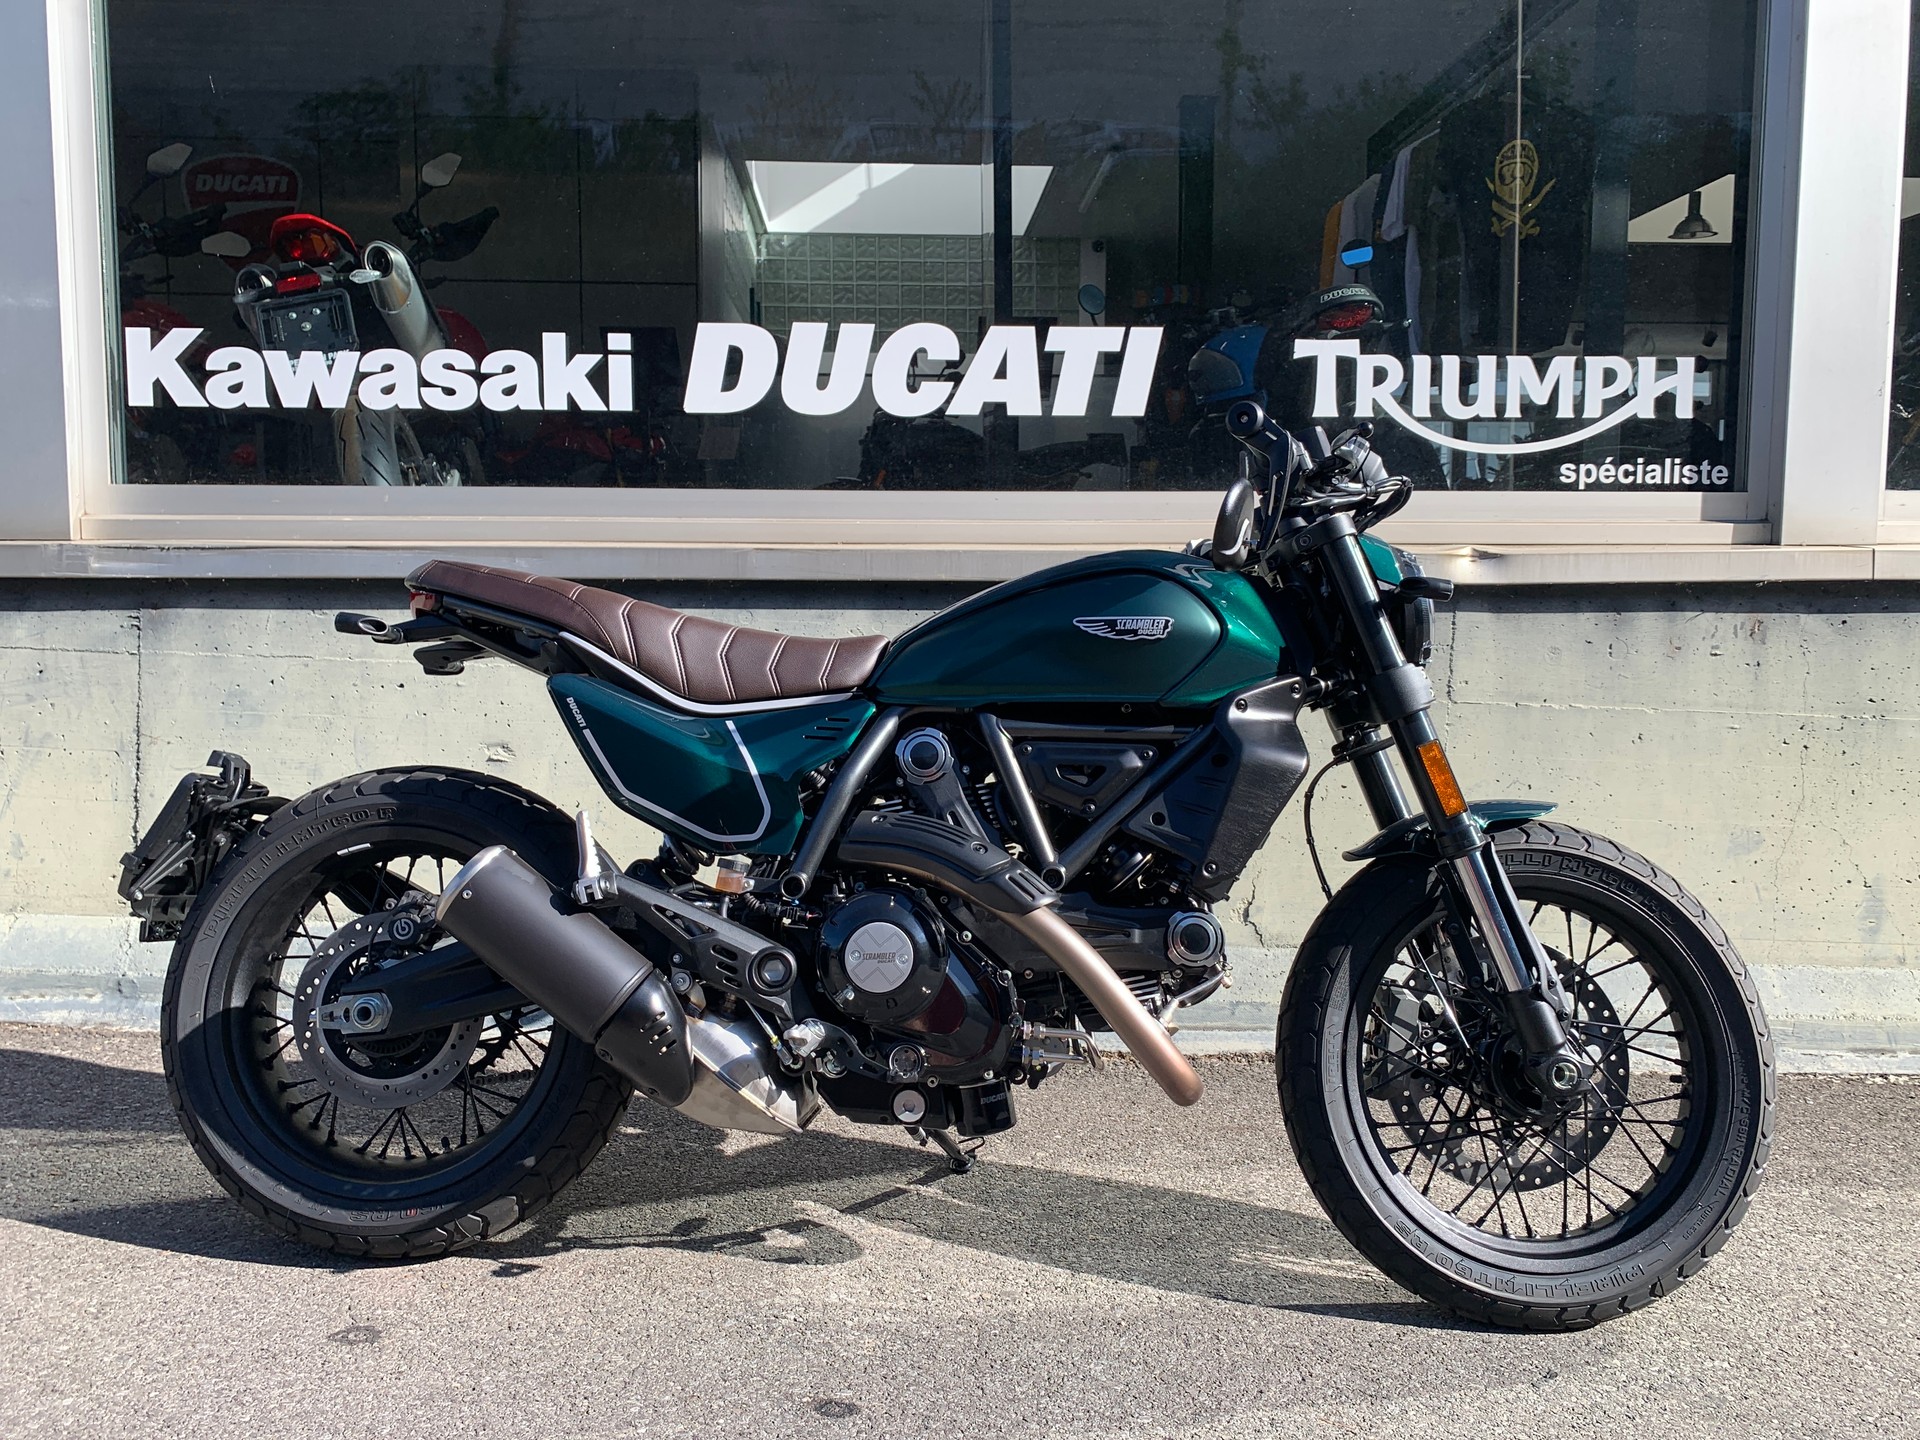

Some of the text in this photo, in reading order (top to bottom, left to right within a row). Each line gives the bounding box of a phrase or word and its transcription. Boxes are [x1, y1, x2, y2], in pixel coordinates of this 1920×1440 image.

[195, 174, 289, 194] DUCATI
[124, 326, 633, 411] Kawasaki
[683, 321, 1164, 416] DUCATI
[1293, 338, 1695, 455] TRIUMPH
[1559, 457, 1729, 486] spécialiste
[1115, 619, 1166, 630] SCRAMBLER
[565, 696, 587, 727] DUCATI
[861, 951, 897, 961] SCRAMBLER
[980, 1092, 1007, 1105] DUCATI
[1714, 1145, 1745, 1198] RADIAL
[1524, 1262, 1646, 1298] PIRELLI
